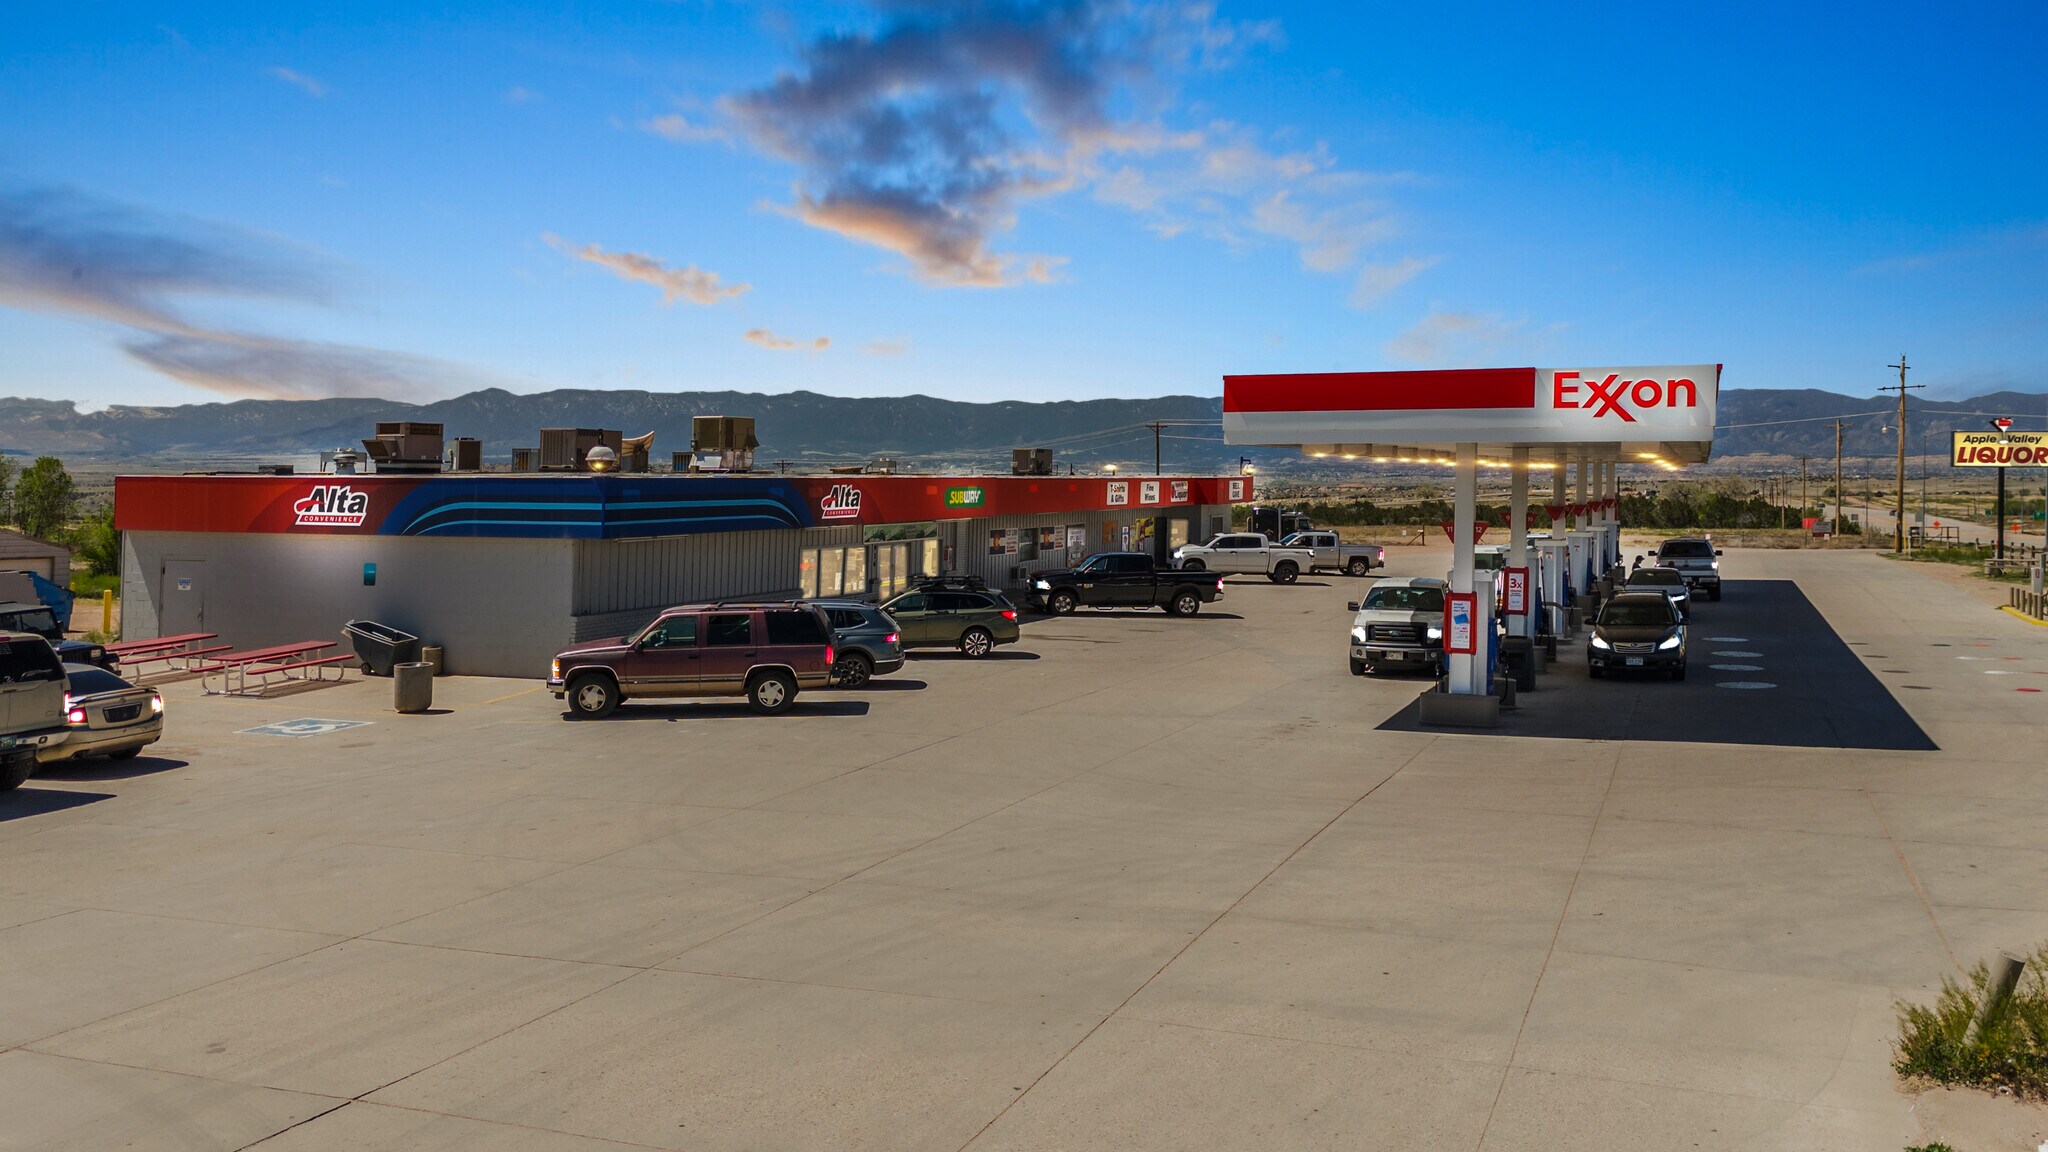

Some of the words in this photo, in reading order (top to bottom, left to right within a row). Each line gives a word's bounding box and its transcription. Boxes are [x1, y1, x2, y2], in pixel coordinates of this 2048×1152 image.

[1553, 371, 1697, 422] Exxon
[1963, 435, 1997, 444] Apple
[2007, 435, 2042, 444] Valley
[1957, 446, 2048, 463] LIQUOR
[300, 488, 365, 513] Alta
[823, 486, 861, 508] Alta
[949, 490, 981, 504] SUBWAY
[1510, 578, 1522, 588] 3x
